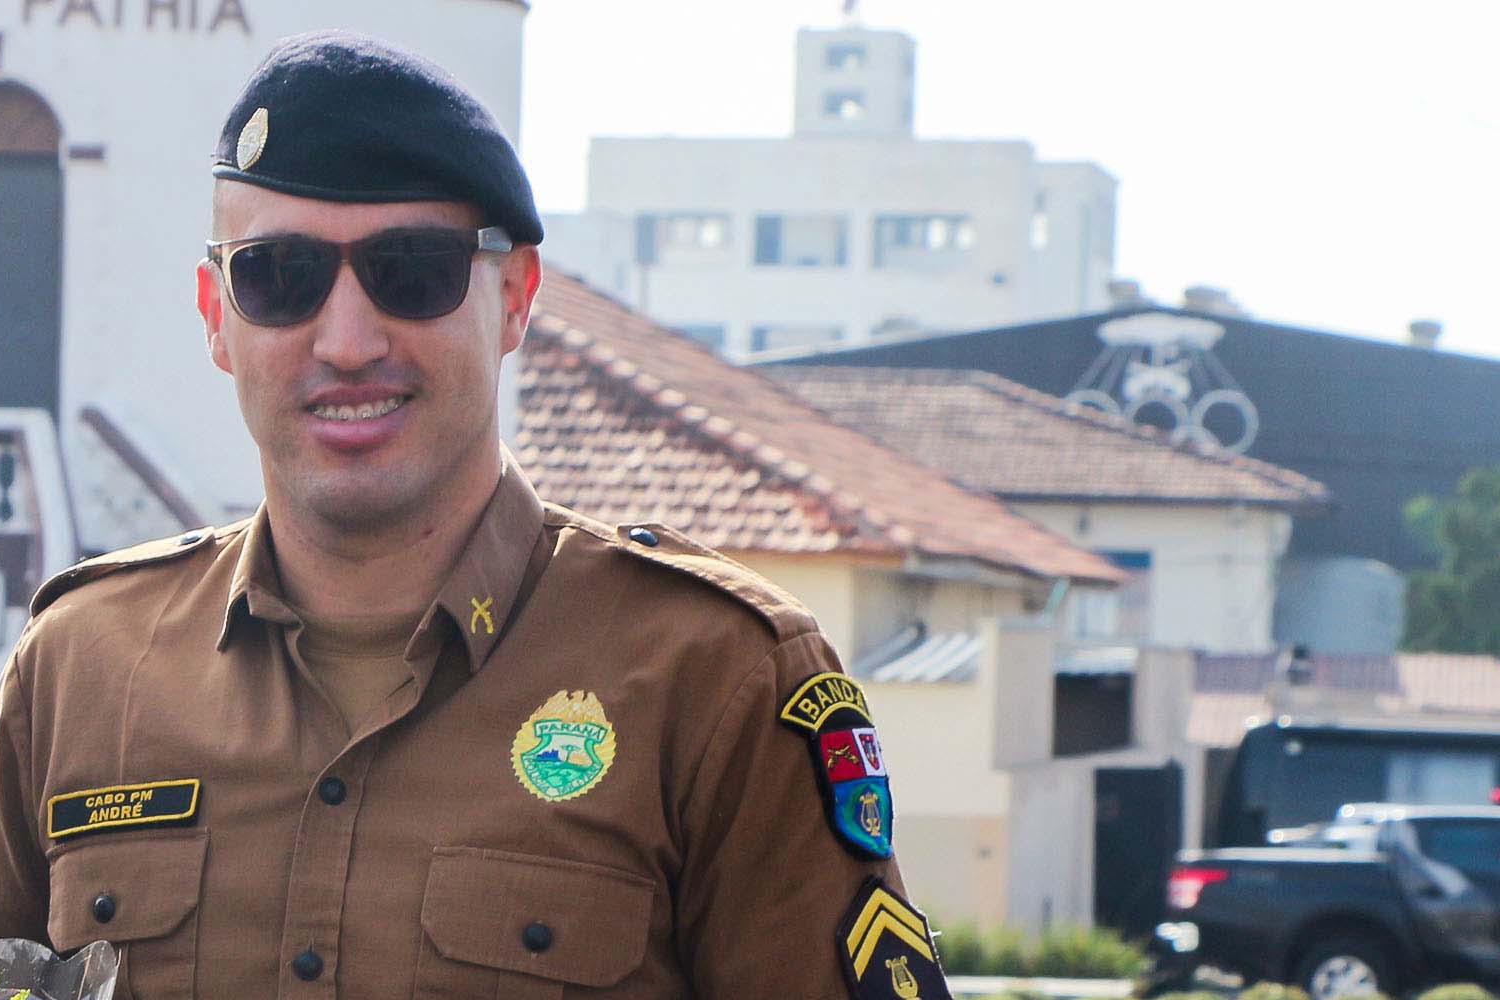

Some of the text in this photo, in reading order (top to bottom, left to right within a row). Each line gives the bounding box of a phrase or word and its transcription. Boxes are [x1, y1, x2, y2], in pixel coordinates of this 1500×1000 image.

[798, 679, 866, 721] BANDA
[85, 789, 153, 808] CABO PM
[88, 801, 143, 824] ANDRÉ
